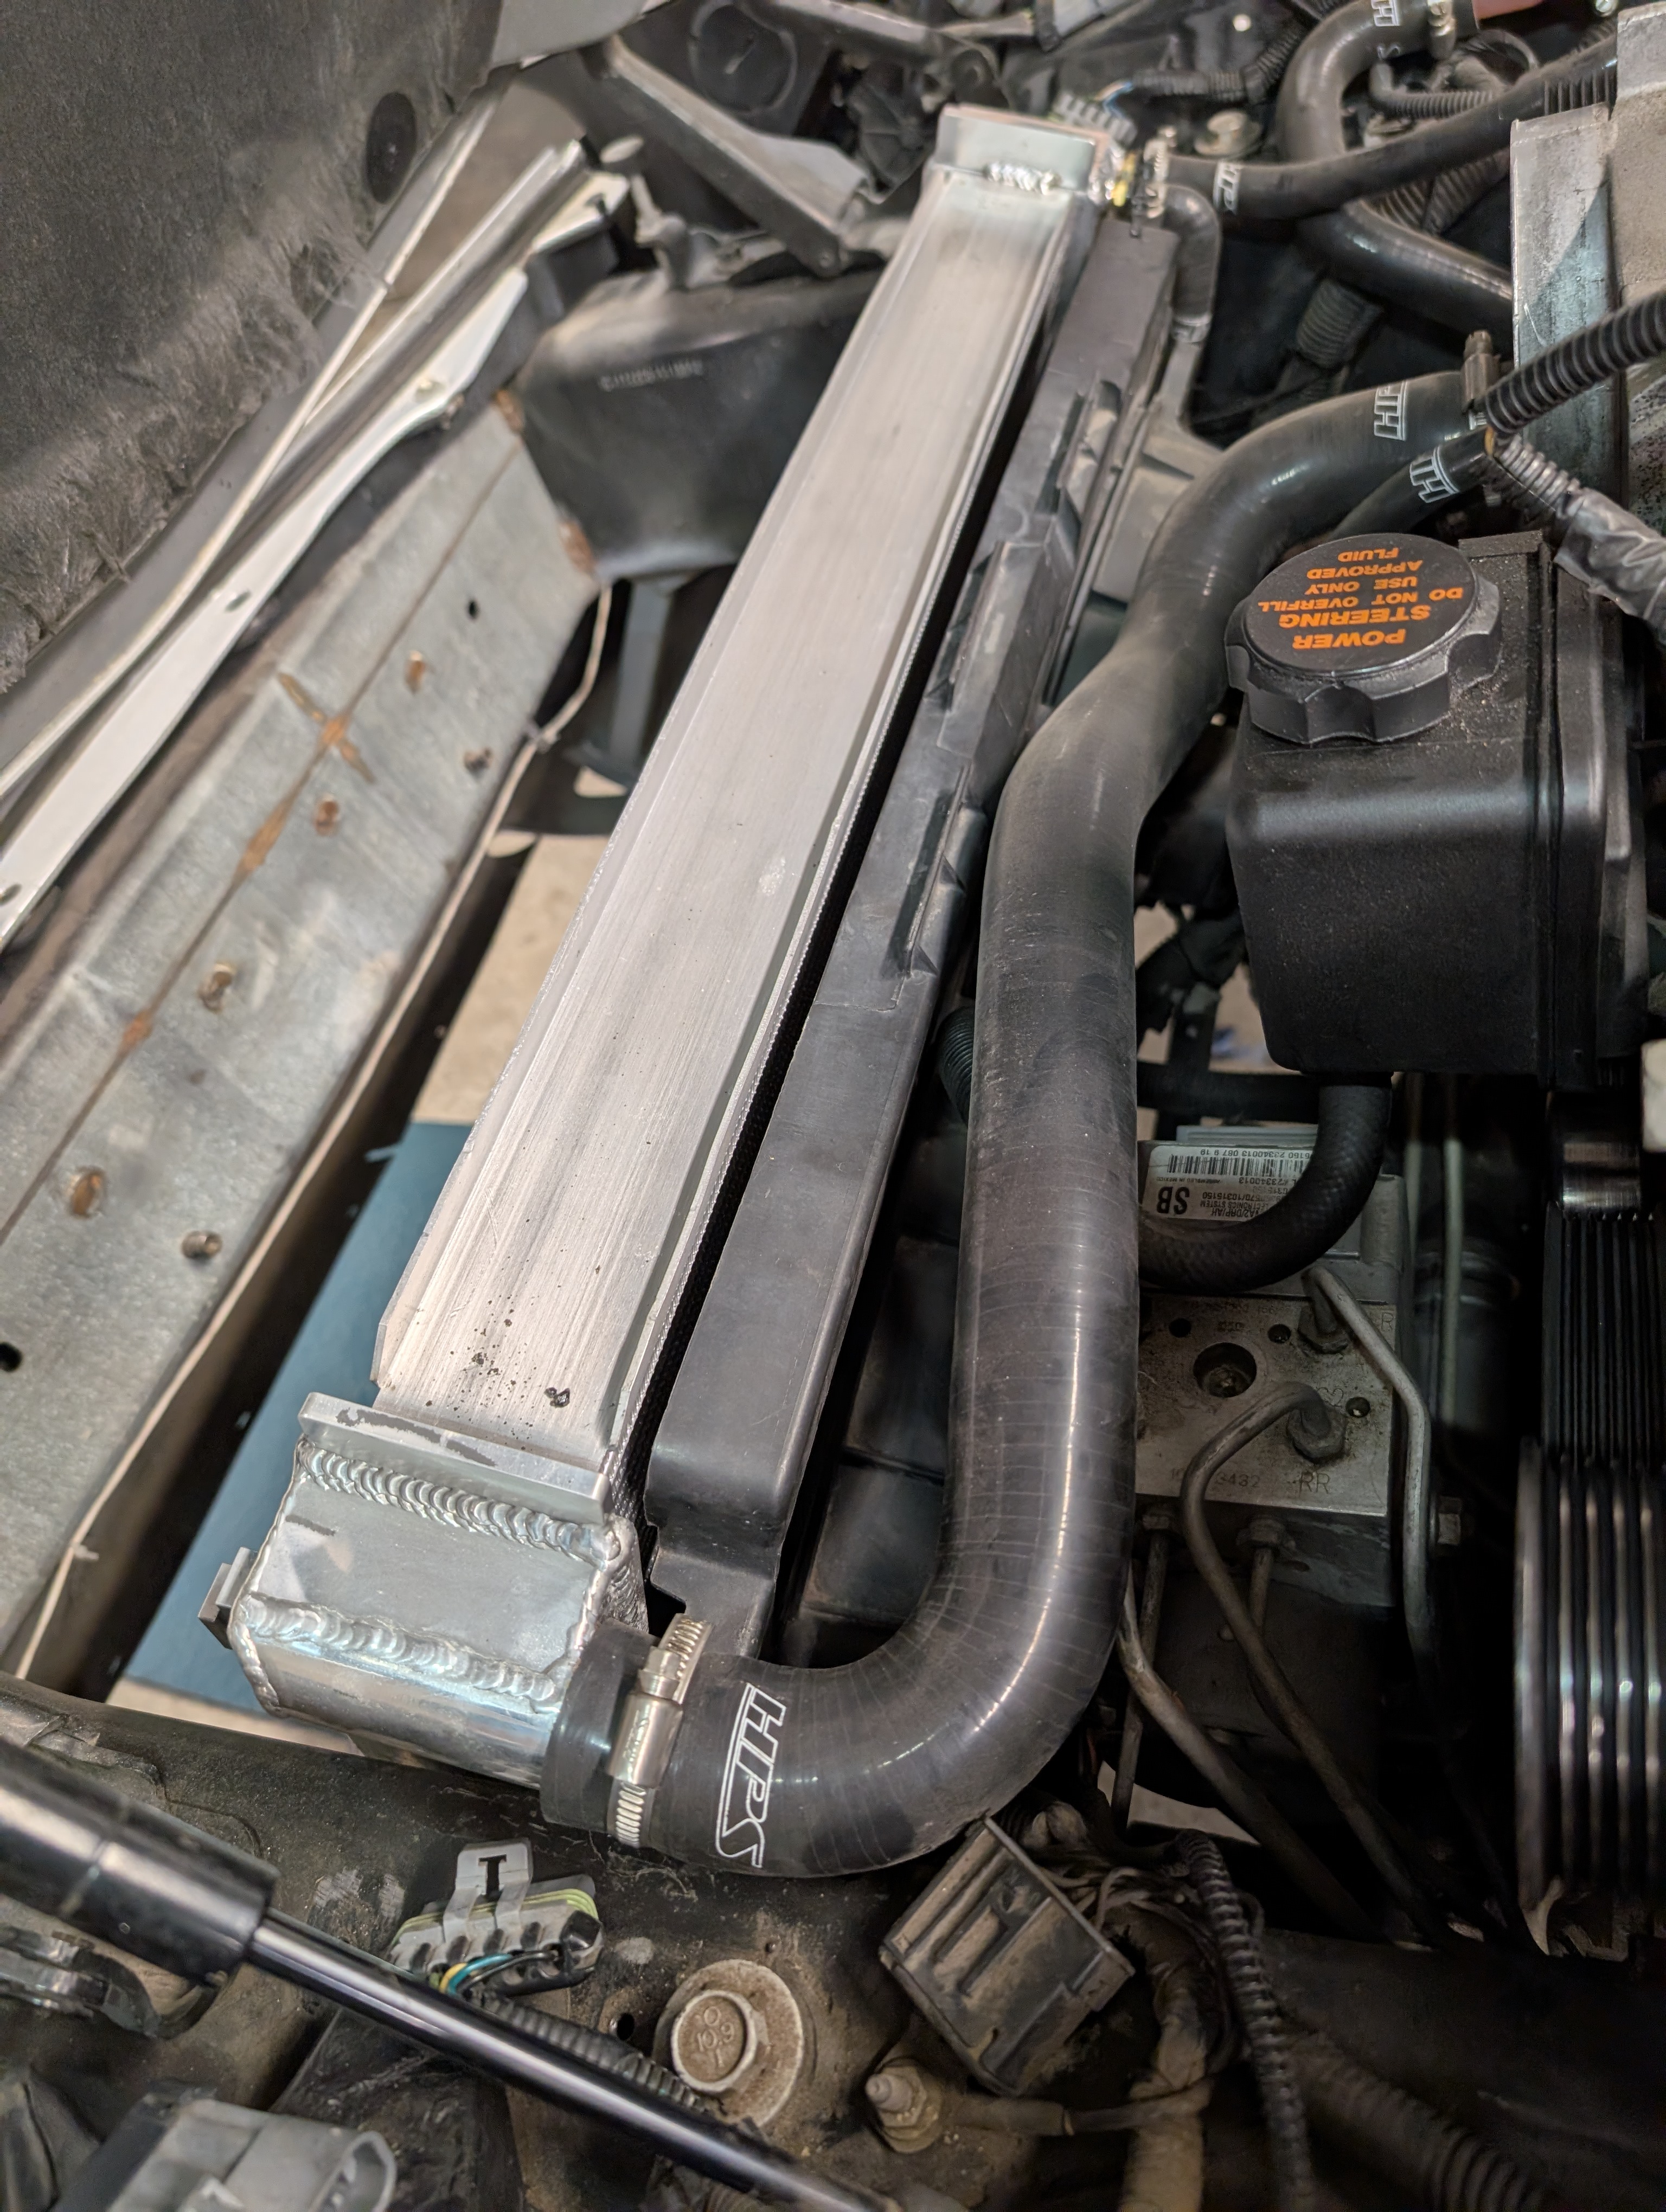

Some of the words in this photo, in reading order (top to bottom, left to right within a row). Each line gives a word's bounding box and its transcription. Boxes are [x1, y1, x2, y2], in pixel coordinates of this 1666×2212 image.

[1338, 548, 1399, 562] FLUID
[1307, 560, 1423, 579] APPROVED
[1305, 581, 1360, 595] ONLY
[1374, 576, 1418, 590] USE
[1372, 591, 1418, 605] NOT
[1428, 587, 1464, 601] DO
[1258, 596, 1359, 612] OVERFILL
[1279, 604, 1431, 628] STEERING
[1292, 629, 1406, 650] POWER
[1156, 1186, 1190, 1215] SB
[715, 1682, 787, 1869] HPS
